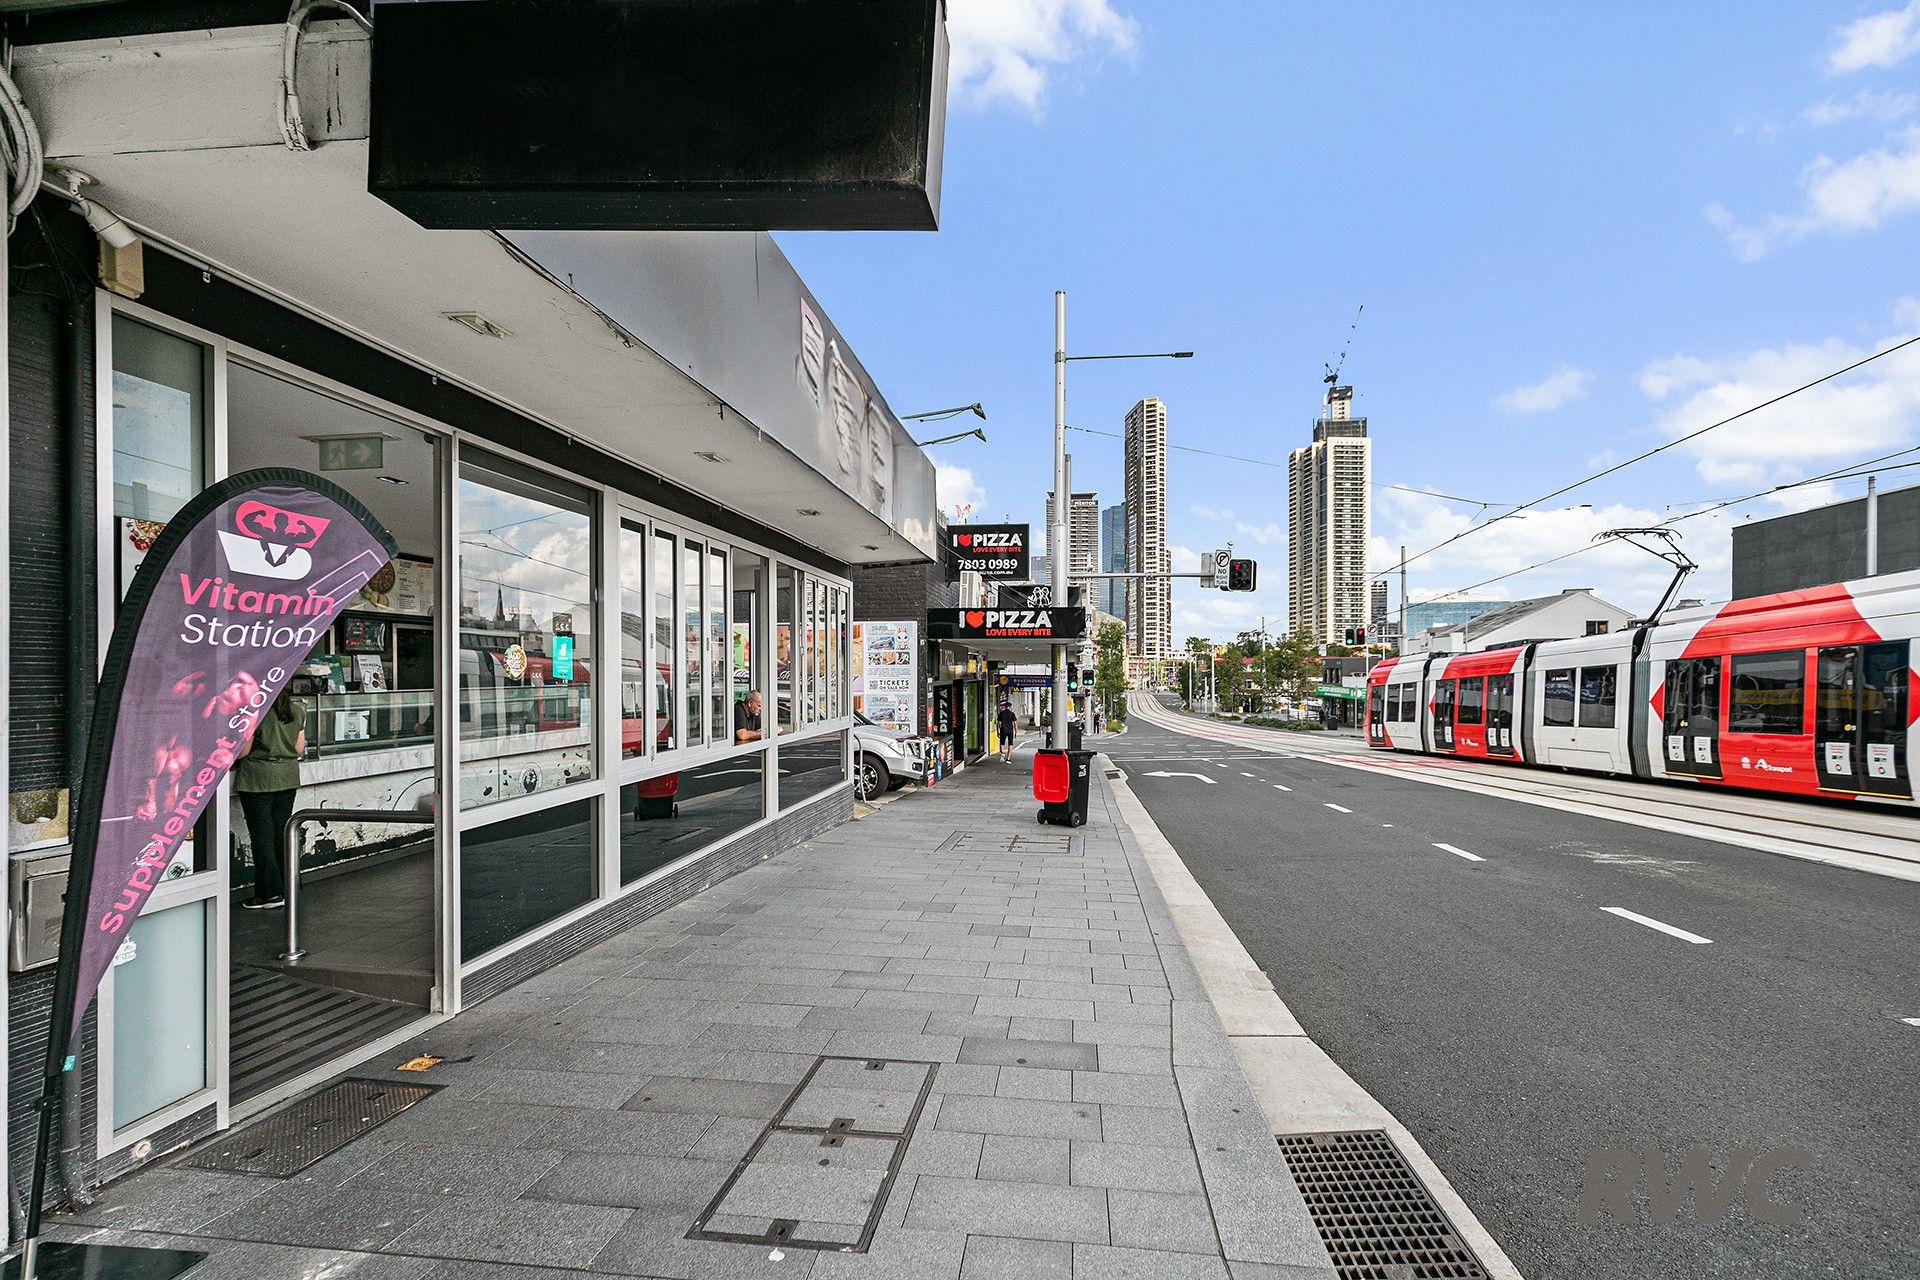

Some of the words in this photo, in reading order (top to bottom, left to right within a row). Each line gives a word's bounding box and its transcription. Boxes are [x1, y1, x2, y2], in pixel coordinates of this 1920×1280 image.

[953, 533, 958, 547] I
[973, 533, 1022, 547] PIZZA
[957, 559, 986, 570] 7803
[988, 558, 1018, 570] 0989
[180, 573, 335, 616] Vitamin
[181, 614, 316, 648] Station
[959, 610, 965, 628] I
[986, 610, 1052, 628] PIZZA
[228, 666, 285, 733] Store
